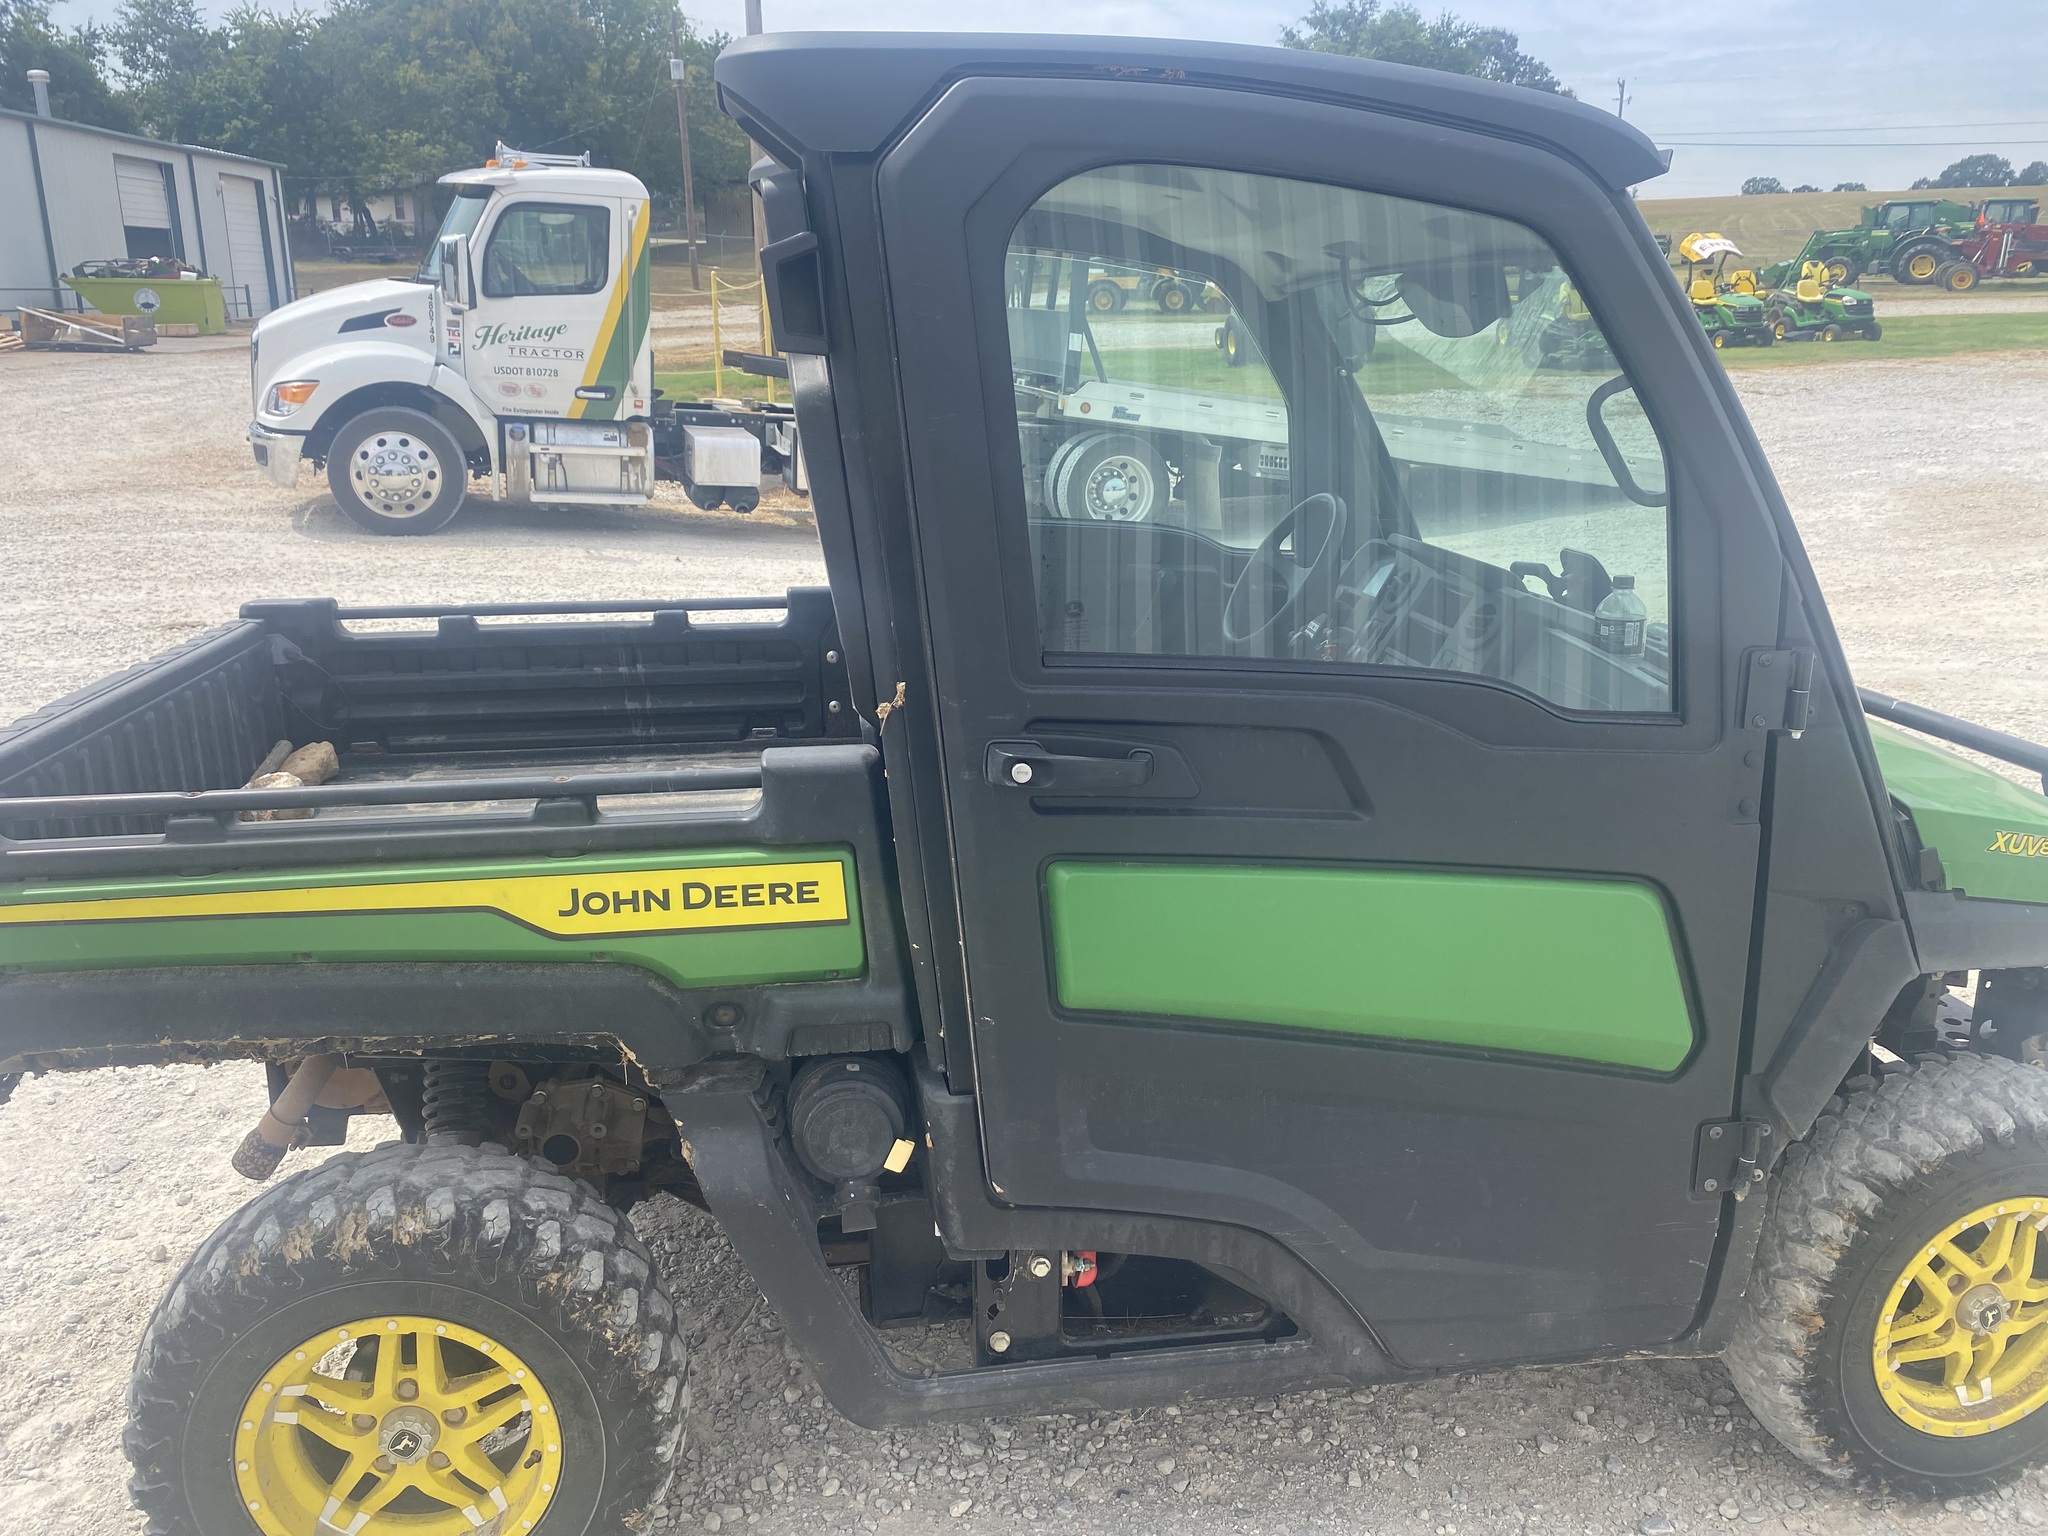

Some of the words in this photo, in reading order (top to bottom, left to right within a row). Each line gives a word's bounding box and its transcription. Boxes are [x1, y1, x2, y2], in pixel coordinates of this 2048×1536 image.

[428, 292, 436, 343] 480749
[471, 322, 568, 351] Heritage
[508, 346, 585, 360] TRACTOR
[493, 366, 524, 376] USDOT
[525, 367, 559, 378] 810728
[558, 887, 671, 917] JOHN
[682, 881, 820, 911] DEERE
